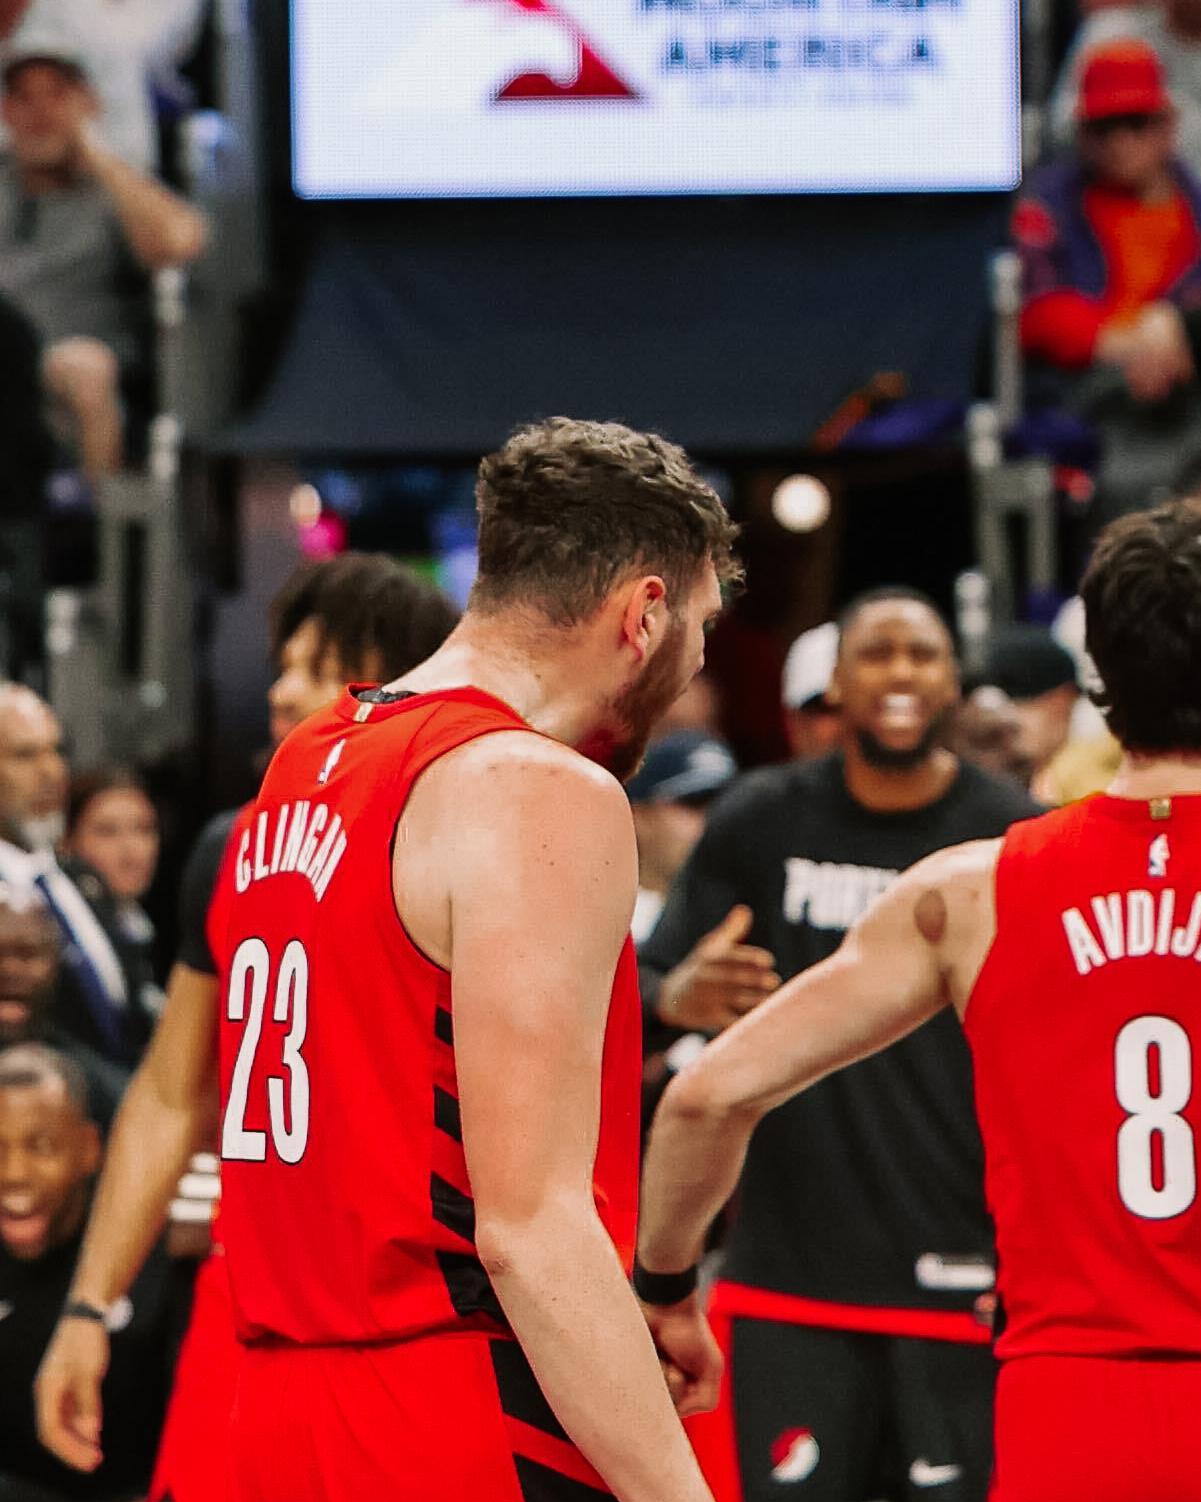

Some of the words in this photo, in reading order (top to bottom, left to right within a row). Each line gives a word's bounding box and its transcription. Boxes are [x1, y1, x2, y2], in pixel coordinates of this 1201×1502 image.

[234, 800, 348, 903] CLINGAN
[221, 936, 310, 1164] 23
[1114, 1014, 1198, 1220] 8
